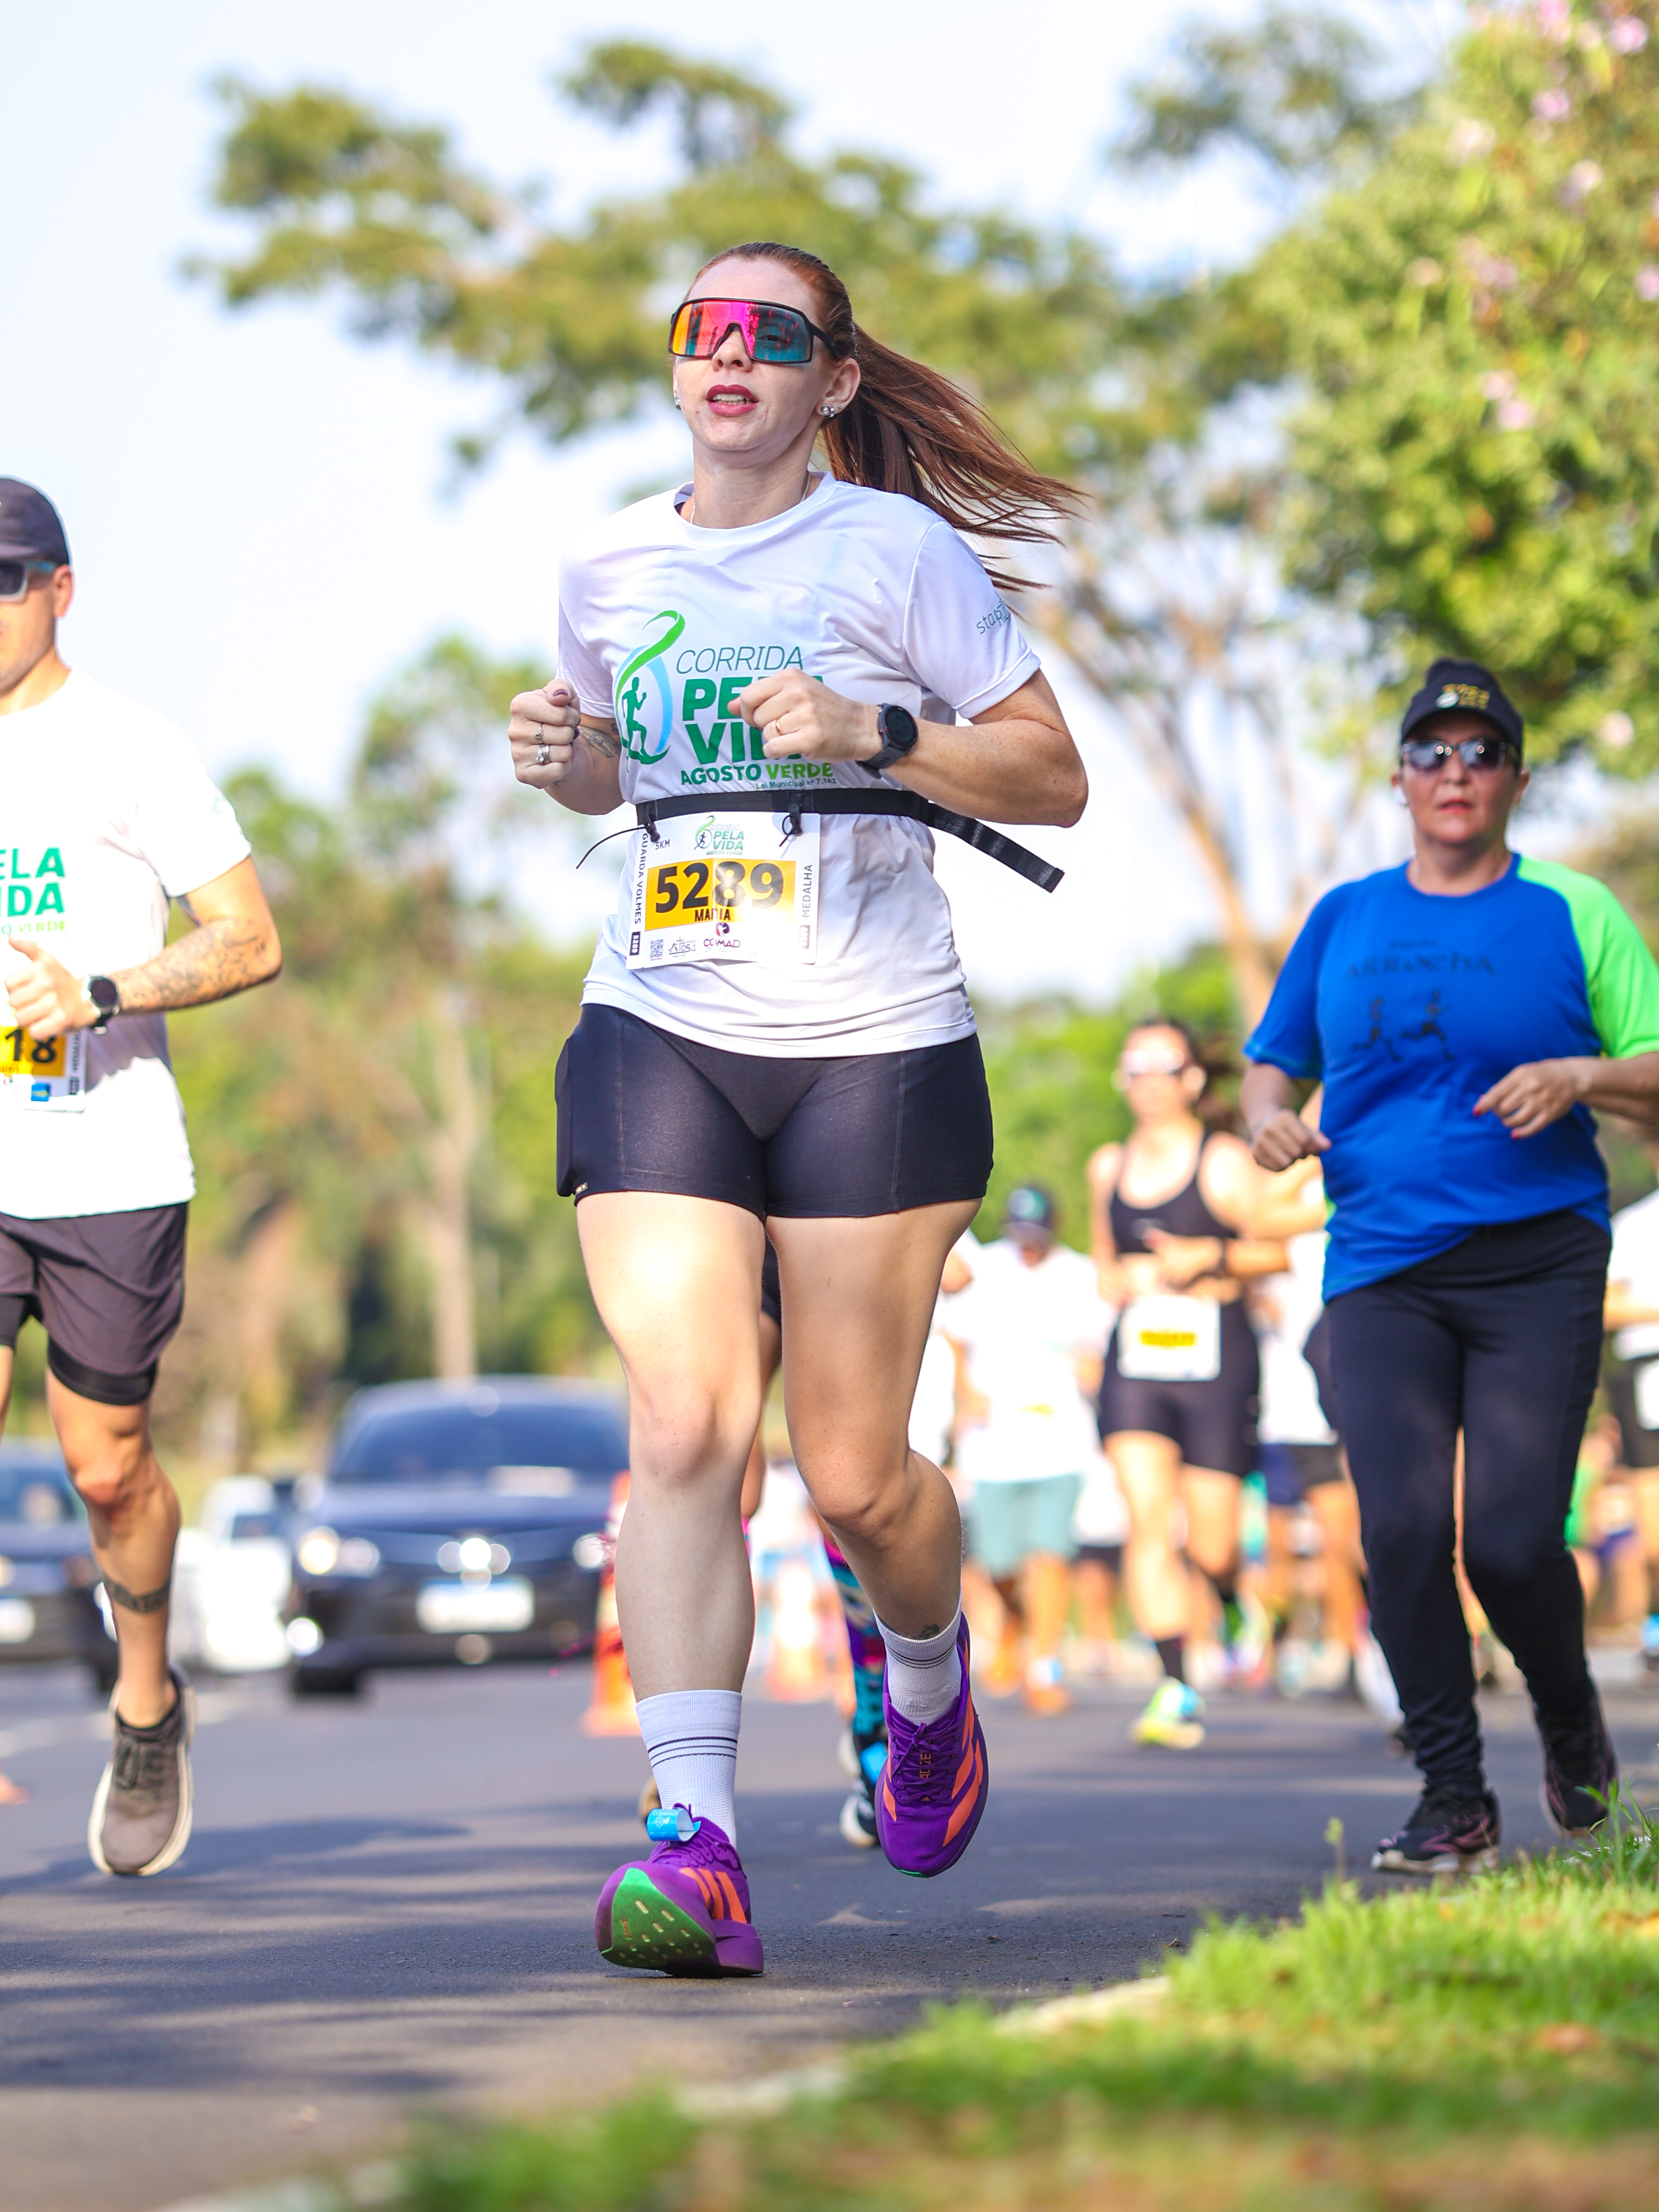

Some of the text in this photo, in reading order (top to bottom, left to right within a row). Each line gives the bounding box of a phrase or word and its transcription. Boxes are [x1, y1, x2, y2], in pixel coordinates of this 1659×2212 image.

[676, 646, 803, 674] CORRIDA
[683, 676, 823, 721] PE
[681, 763, 833, 785] AGOSTO VERDE
[770, 780, 805, 788] Municipal
[655, 839, 671, 850] 5KM
[712, 841, 744, 851] VIDA
[713, 831, 744, 840] PELA
[635, 833, 648, 924] GUARDA VOLMES
[655, 861, 784, 914] 5289
[802, 864, 813, 918] MEDALHA
